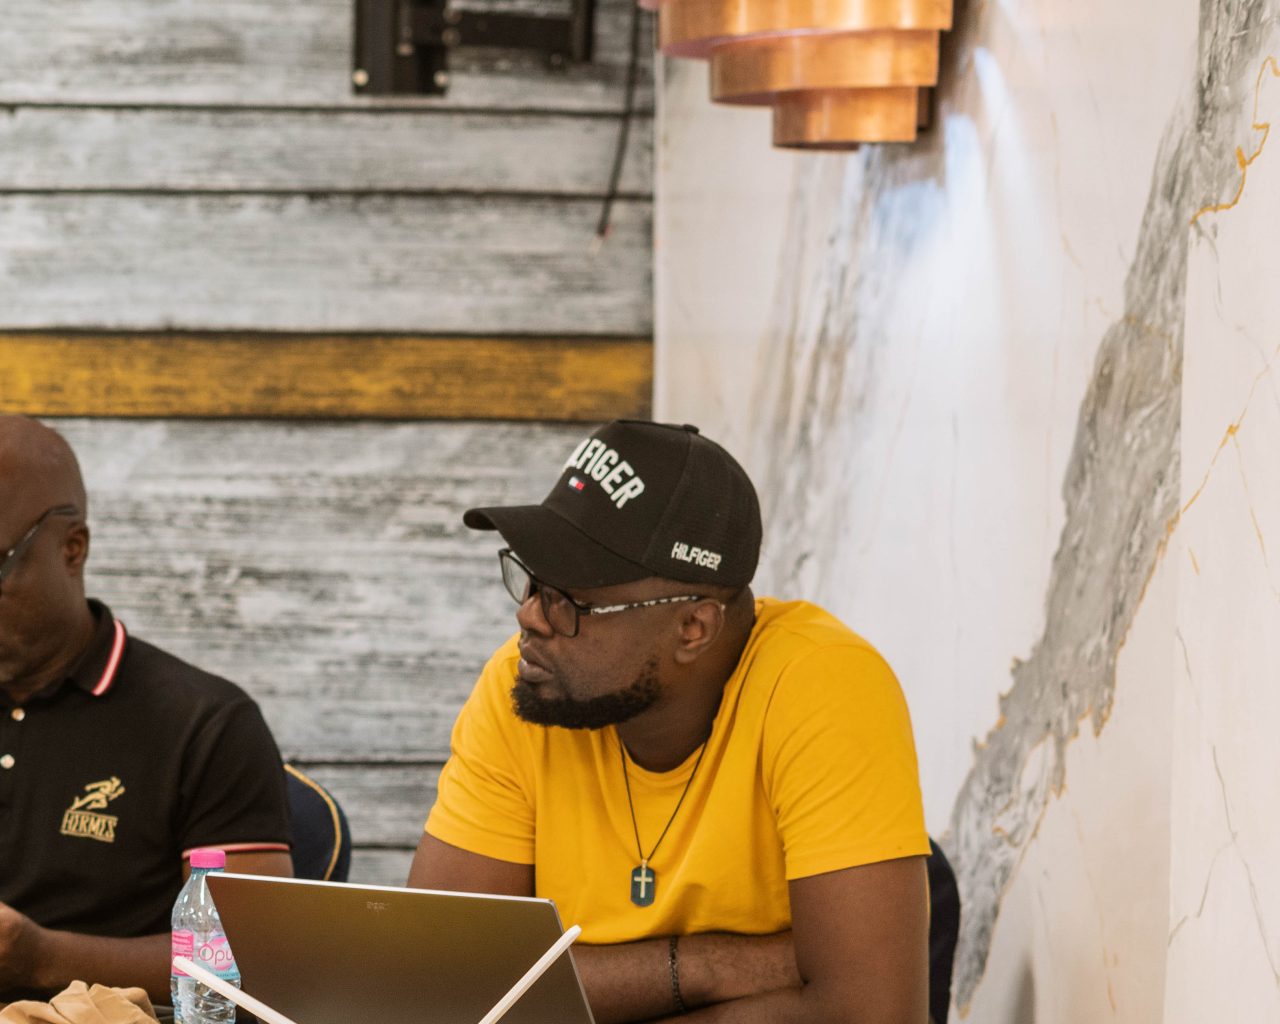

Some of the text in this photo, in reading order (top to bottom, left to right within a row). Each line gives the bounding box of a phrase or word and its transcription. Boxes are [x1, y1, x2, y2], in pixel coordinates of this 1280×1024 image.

[564, 438, 646, 510] LFIGER
[671, 541, 722, 571] HILFIGER
[197, 942, 235, 966] Opu
